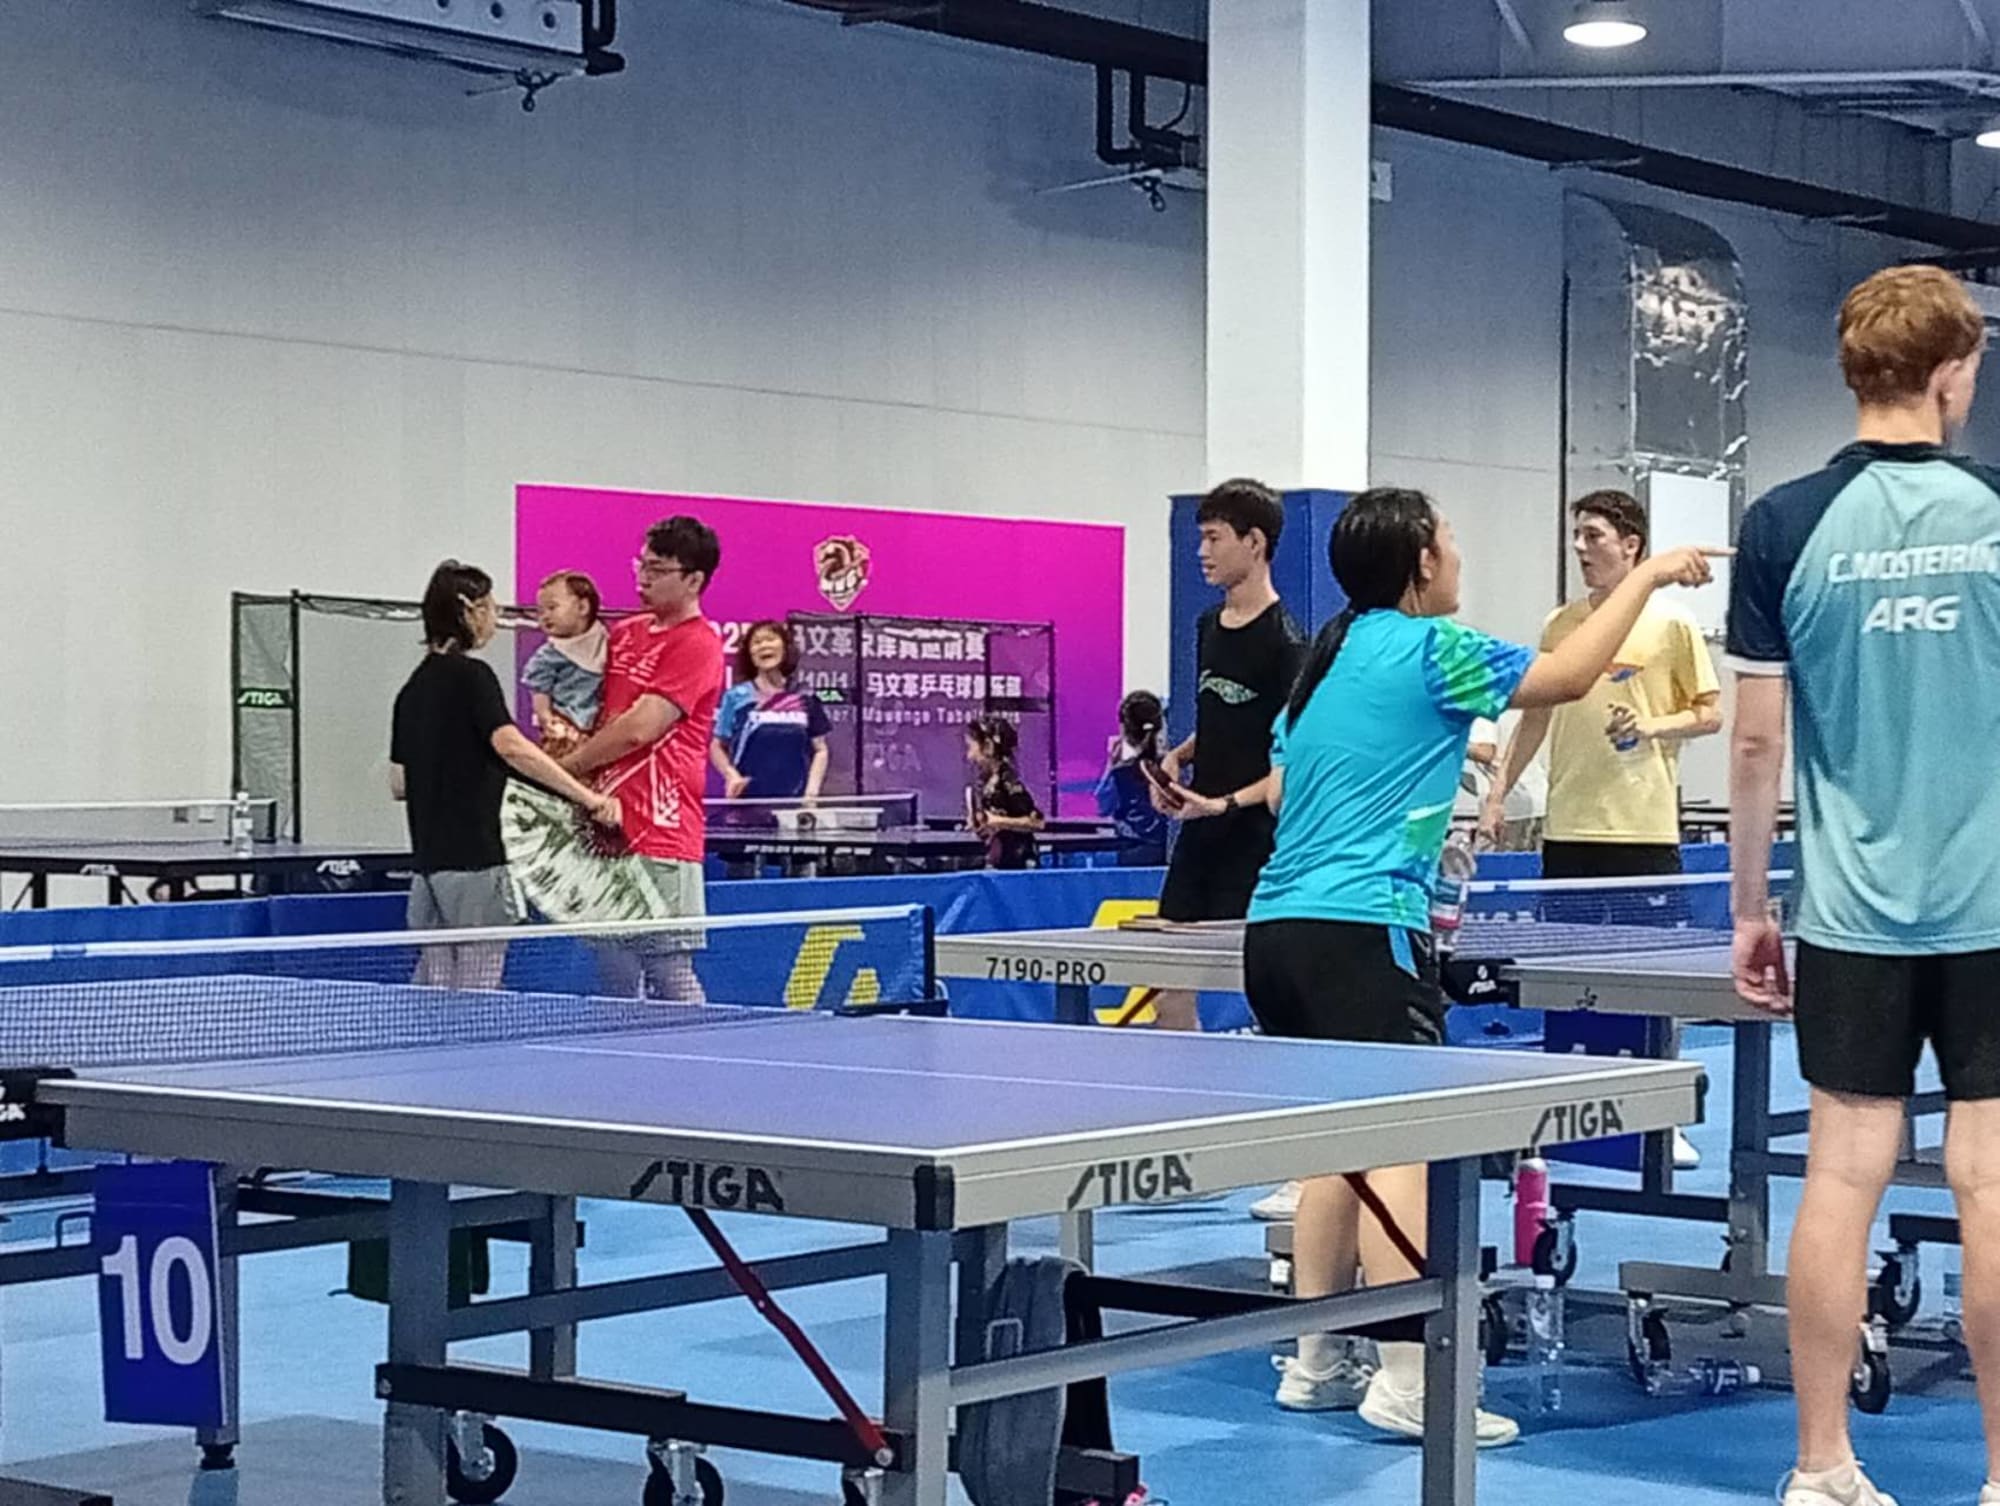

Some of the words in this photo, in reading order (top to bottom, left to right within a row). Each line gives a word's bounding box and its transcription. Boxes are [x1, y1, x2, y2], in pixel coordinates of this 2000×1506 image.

[1861, 595, 1960, 634] ARG
[237, 691, 285, 706] STIGA
[985, 957, 1106, 986] 7190-PRO
[1530, 1099, 1623, 1146] STIGA
[630, 1160, 785, 1212] STIGA
[1067, 1153, 1193, 1211] STIGA
[101, 1234, 213, 1366] 10
